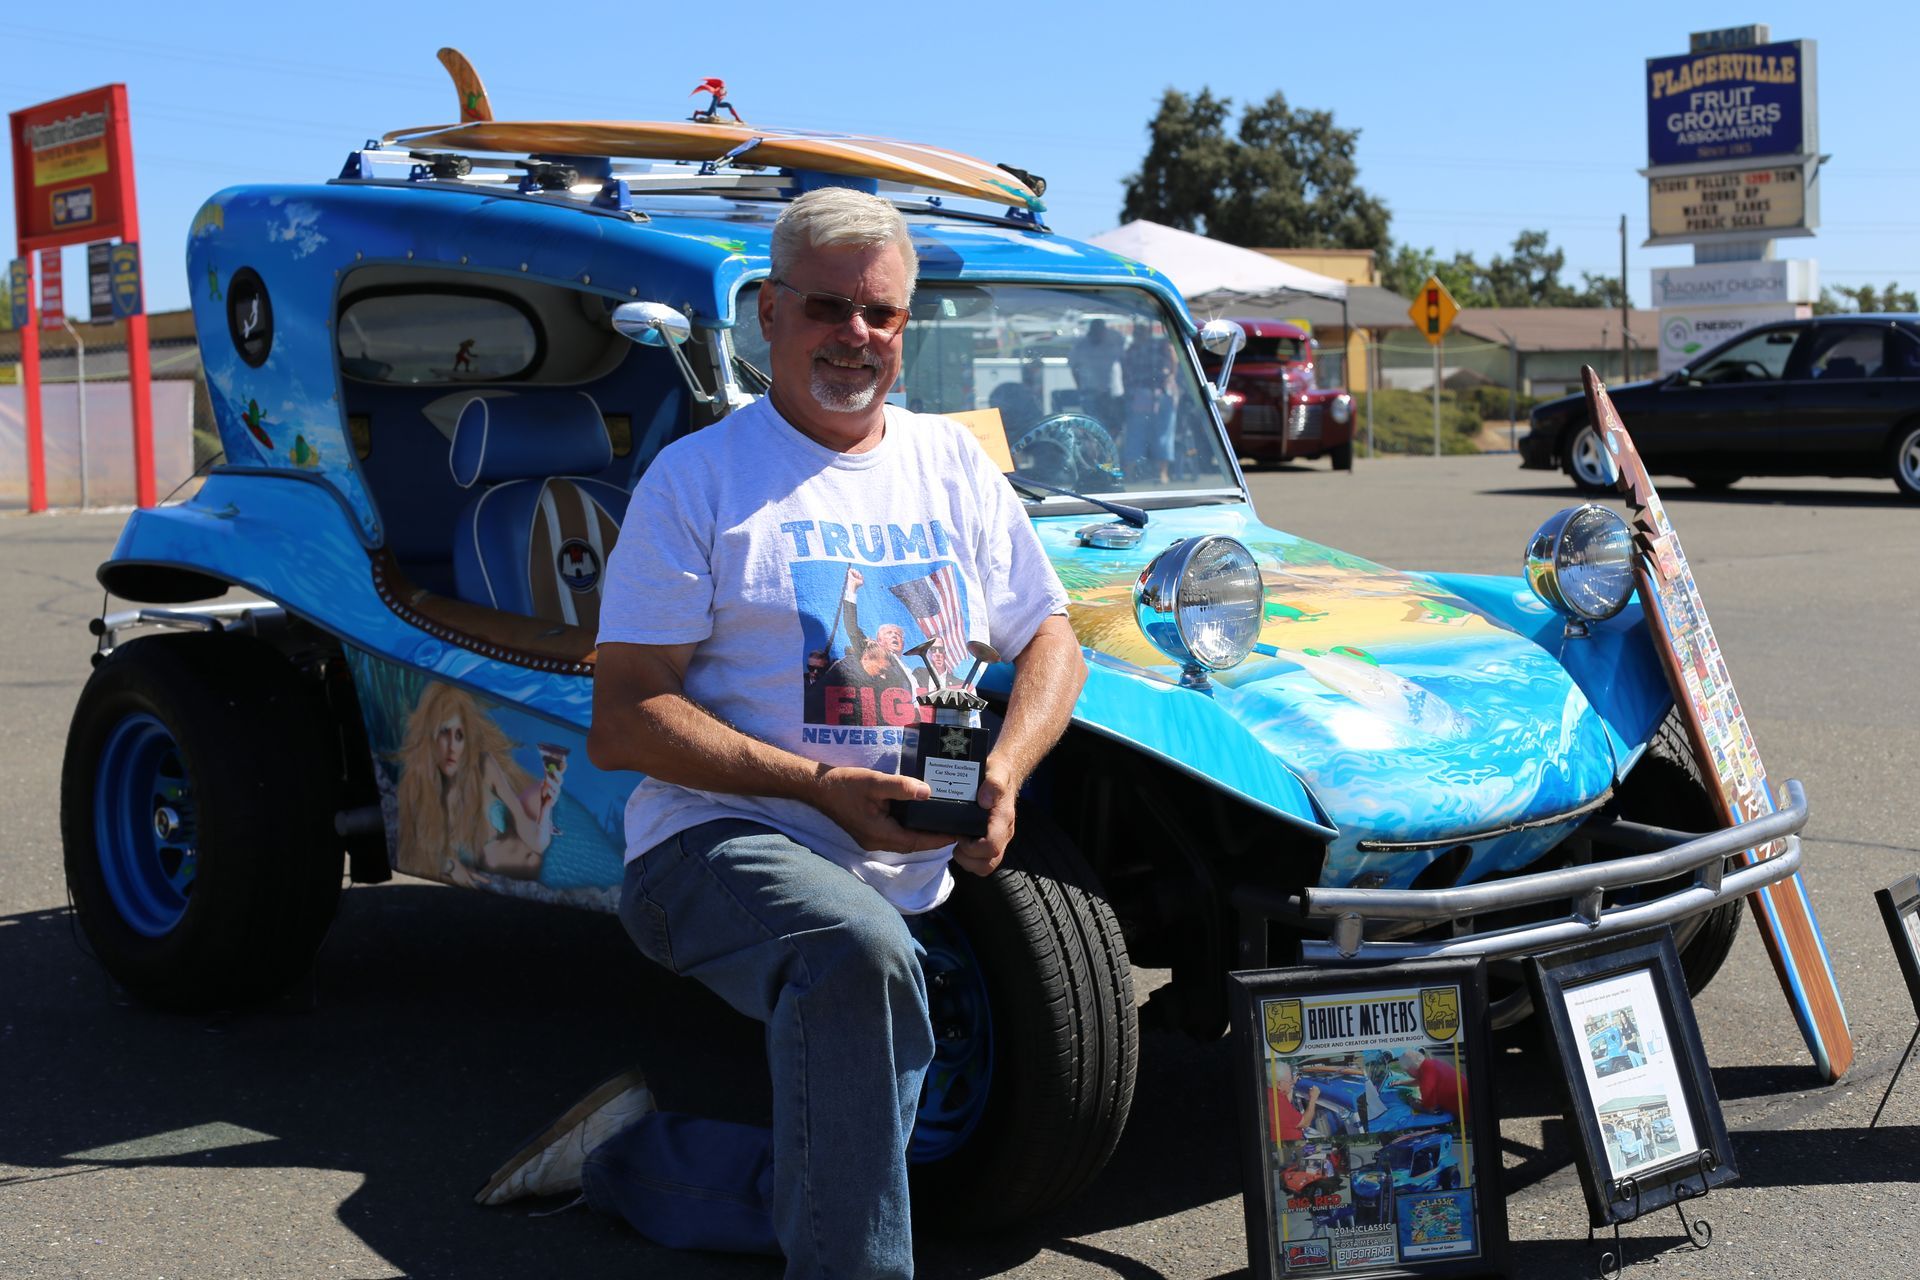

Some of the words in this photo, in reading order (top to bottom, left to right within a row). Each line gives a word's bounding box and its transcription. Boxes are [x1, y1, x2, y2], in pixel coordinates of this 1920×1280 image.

[1652, 53, 1796, 99] PLACERVILLE
[1690, 86, 1755, 111] FRUIT
[1666, 102, 1781, 133] GROWERS
[1677, 124, 1772, 145] ASSOCIATION
[1695, 175, 1741, 190] PELLETS
[1683, 204, 1718, 217] WATER
[1686, 216, 1725, 231] PUBLIC
[1731, 214, 1764, 228] SCALE
[1668, 279, 1724, 295] RADIANT
[1726, 277, 1784, 293] CHURCH
[1695, 320, 1744, 332] ENERGY
[825, 685, 973, 727] FIG
[802, 727, 878, 745] NEVER
[948, 788, 964, 796] Unique
[1308, 1006, 1354, 1040] BRUCE
[1359, 1001, 1417, 1036] MEYERS
[1305, 1042, 1330, 1050] FOUNDER
[1357, 1222, 1391, 1233] CLASSIC
[1335, 1240, 1358, 1249] COSTA
[1339, 1246, 1392, 1260] BUGORAMA
